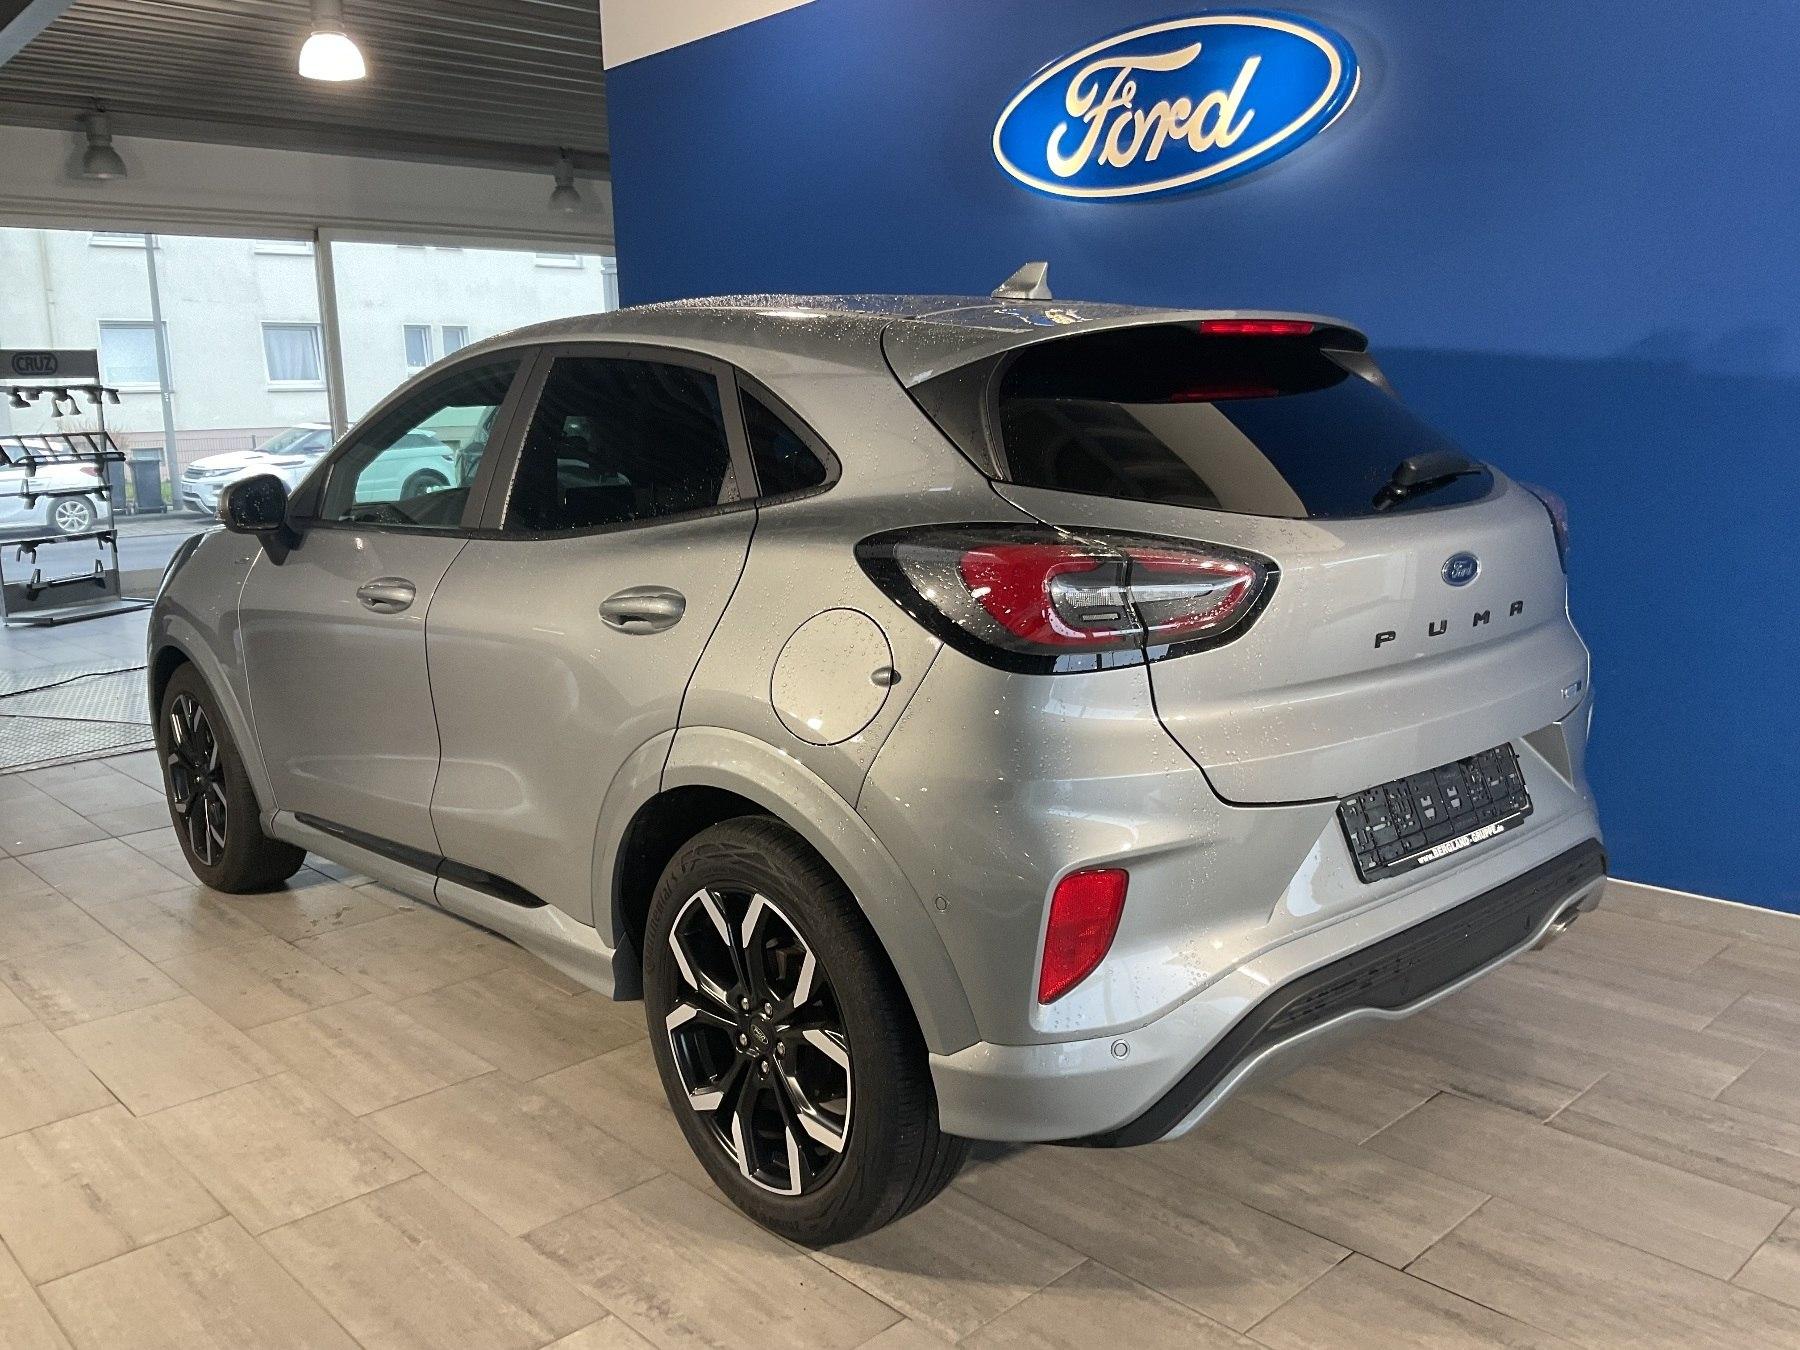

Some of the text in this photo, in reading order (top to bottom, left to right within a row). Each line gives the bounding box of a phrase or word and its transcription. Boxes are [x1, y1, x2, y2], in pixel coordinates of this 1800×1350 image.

[1046, 42, 1262, 178] Ford
[15, 355, 54, 371] CRUZ
[1451, 559, 1473, 579] Ford
[1374, 600, 1524, 649] PUMA
